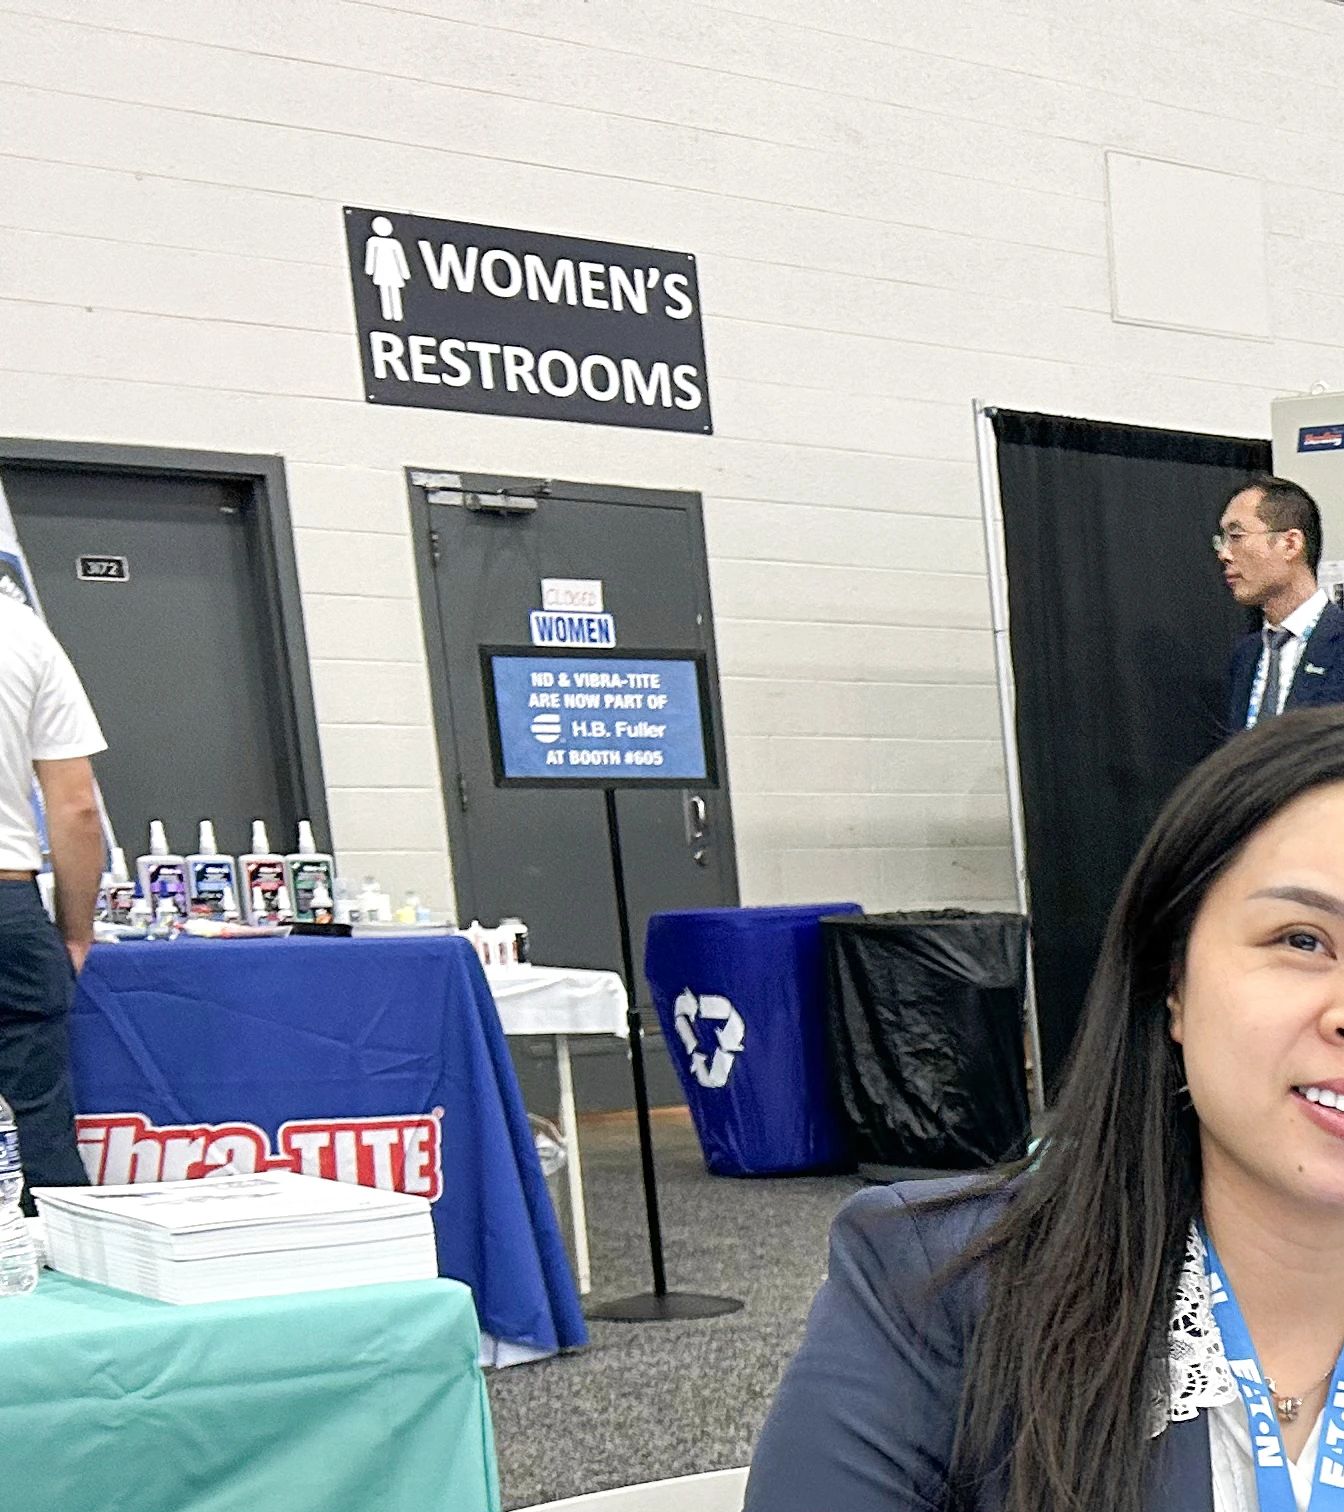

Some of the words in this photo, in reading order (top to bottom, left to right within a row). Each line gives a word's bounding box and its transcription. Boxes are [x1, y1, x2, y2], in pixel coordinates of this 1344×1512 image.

[416, 239, 694, 321] WOMEN'S
[368, 330, 702, 411] RESTROOMS
[534, 615, 611, 644] WOMEN
[530, 672, 553, 688] ND
[557, 672, 571, 688] &
[574, 672, 661, 689] VIBRA-TITE
[528, 693, 560, 709] ARE
[563, 693, 600, 709] NOW
[604, 694, 643, 709] PART
[647, 694, 668, 709] OF
[571, 720, 611, 738] H.B.
[615, 720, 667, 738] Fuller
[545, 750, 564, 765] AT
[568, 750, 621, 765] BOOTH
[624, 750, 664, 766] #605
[1229, 1358, 1284, 1468] EATON
